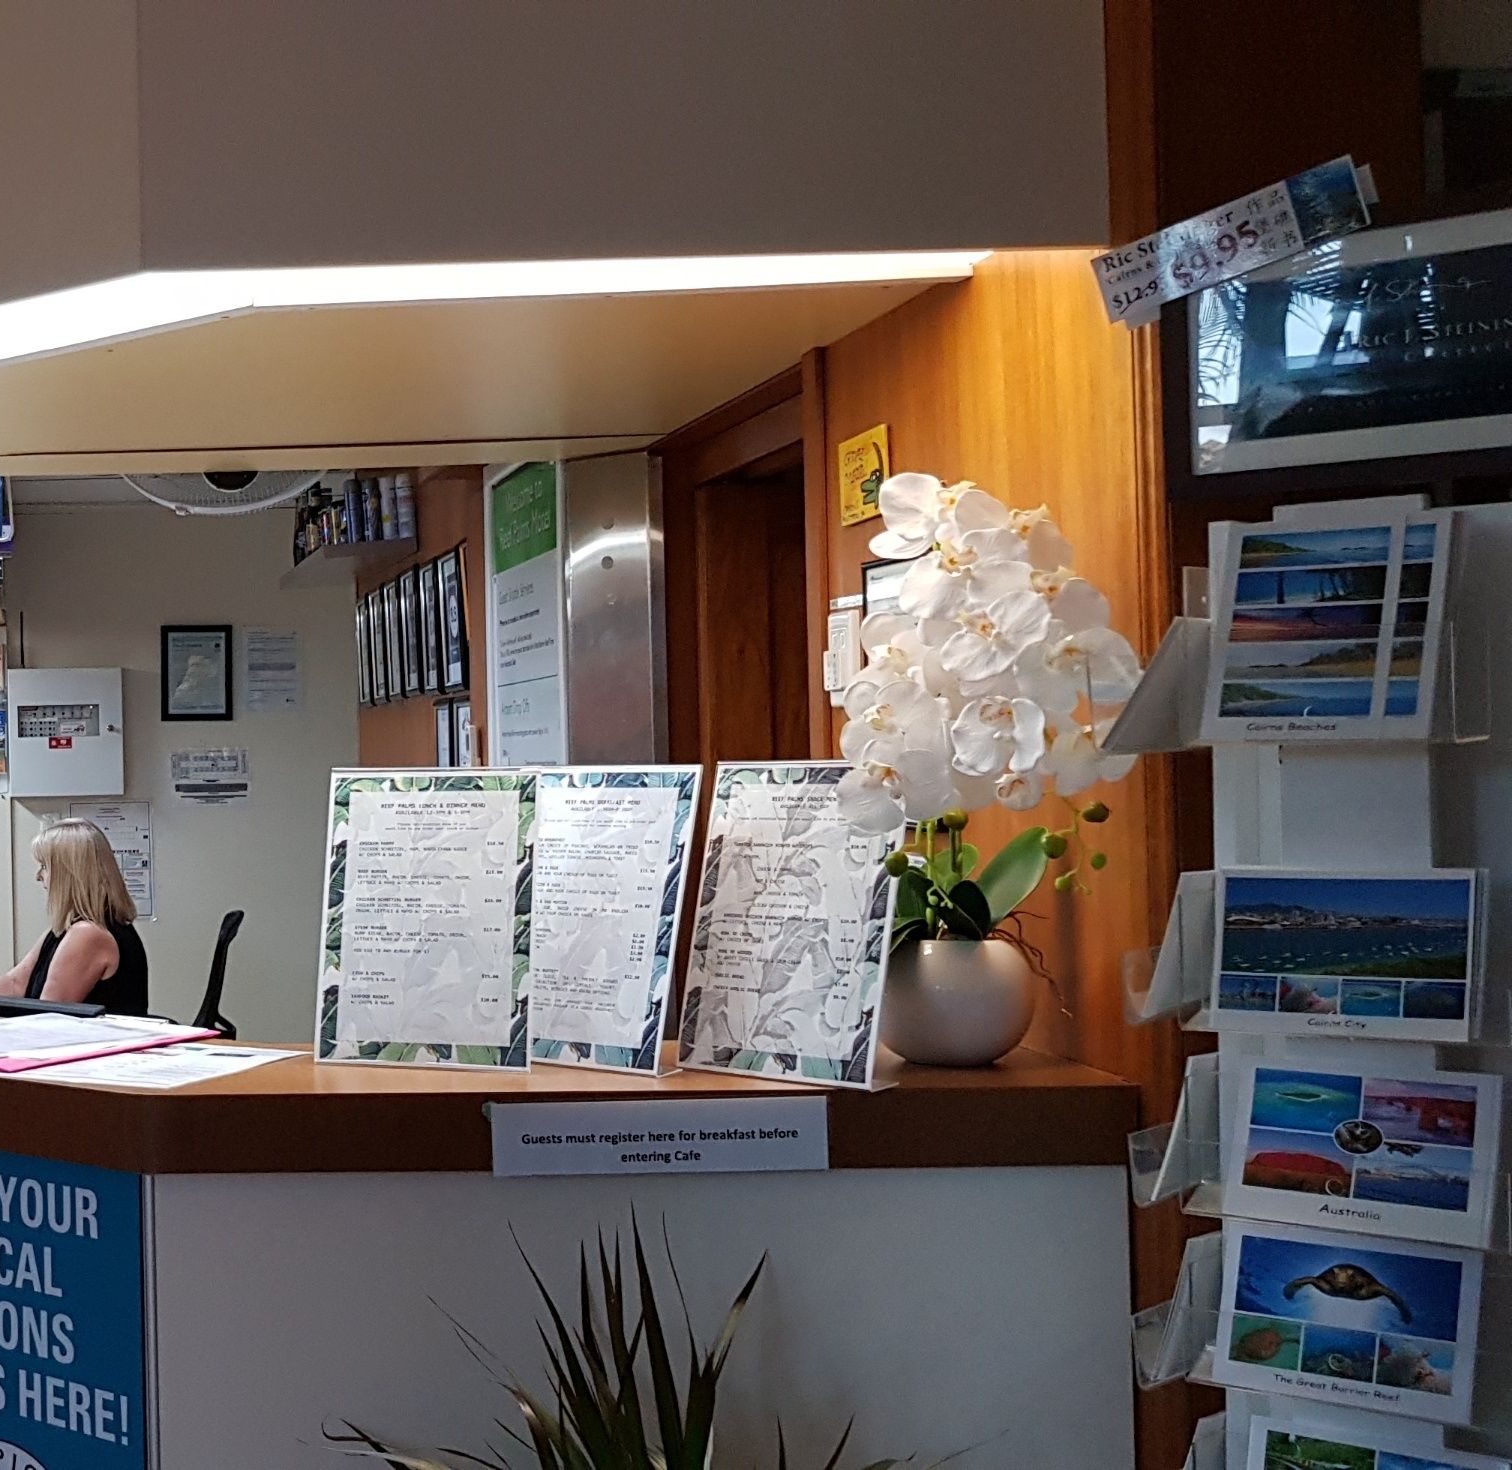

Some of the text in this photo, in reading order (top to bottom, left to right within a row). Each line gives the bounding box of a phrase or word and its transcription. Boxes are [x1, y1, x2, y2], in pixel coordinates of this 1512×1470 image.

[1102, 250, 1132, 273] Ric
[1171, 219, 1260, 288] $9.95
[1111, 280, 1159, 309] $12.9
[1287, 722, 1337, 731] Beaches
[521, 1127, 799, 1146] Guests must register here for breakfast before
[621, 1150, 701, 1164] entering Cafe
[1318, 1204, 1381, 1221] Australia
[1273, 1373, 1401, 1402] The Great Barrier Reef
[18, 1368, 129, 1447] HERE!
